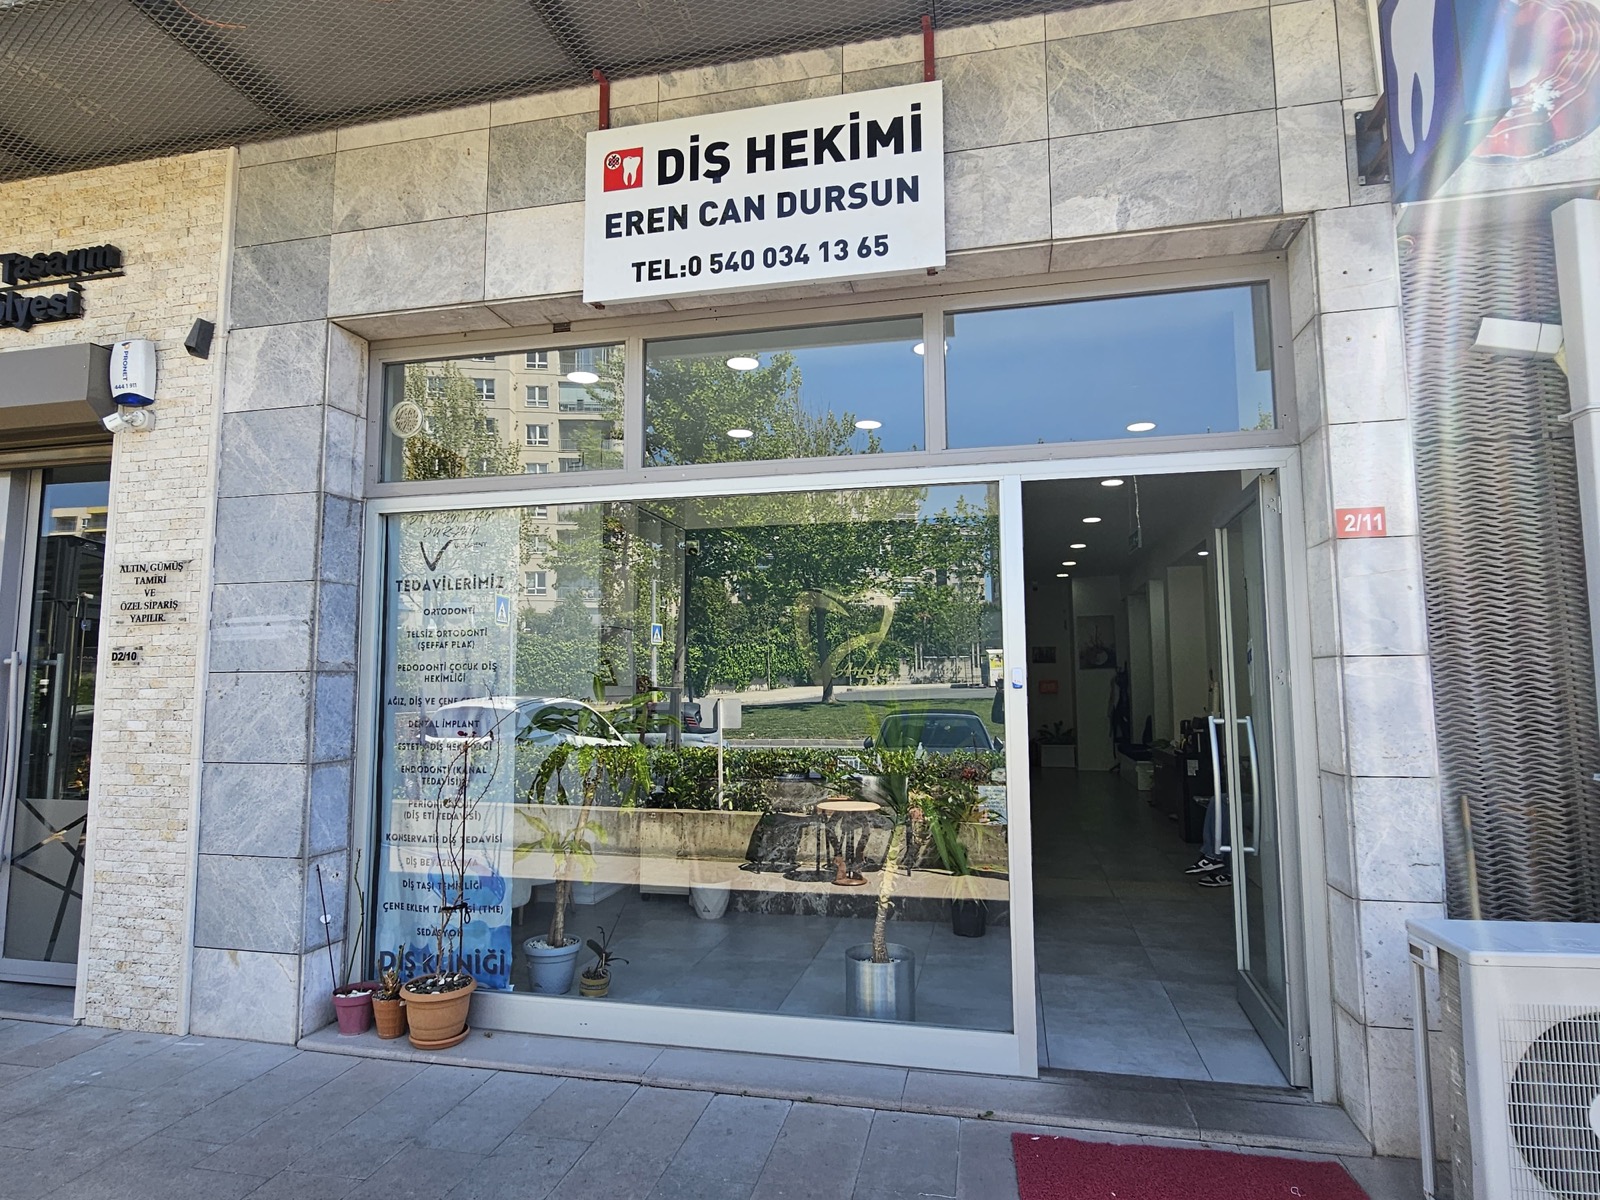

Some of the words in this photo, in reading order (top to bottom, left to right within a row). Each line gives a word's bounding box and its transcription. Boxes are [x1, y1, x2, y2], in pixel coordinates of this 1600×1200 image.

[657, 134, 731, 186] DİŞ
[746, 102, 923, 176] HEKİMİ
[605, 203, 689, 240] EREN
[698, 194, 765, 228] CAN
[776, 175, 920, 220] DURSUN
[709, 249, 754, 274] 540
[762, 244, 810, 269] 034
[818, 238, 849, 263] 13
[856, 234, 889, 259] 65
[1344, 513, 1383, 532] 2/11
[119, 563, 148, 574] ALTIN,
[150, 560, 184, 573] GÜMÜŞ
[134, 573, 167, 585] TAMİRİ
[396, 573, 504, 593] TEDAVİLERİMİZ
[144, 589, 156, 597] VE
[120, 601, 142, 611] ÖZEL
[143, 598, 178, 611] SİPARİŞ
[130, 613, 166, 623] YAPILIR.
[407, 629, 433, 638] TELSİZ
[436, 627, 488, 638] ORTODONTİ
[111, 651, 137, 661] D2/10
[397, 662, 447, 672] PEDODONTİ
[449, 662, 478, 673] ÇOCUK
[481, 660, 498, 671] DİŞ
[424, 671, 466, 683] HEKİMLİĞİ
[409, 696, 422, 707] DİŞ
[442, 718, 480, 728] İMPLANT
[422, 810, 434, 820] ETİ
[405, 856, 417, 868] DİŞ
[402, 878, 414, 892] DİŞ
[382, 902, 405, 912] ÇENE
[406, 903, 430, 913] EKLEM
[478, 905, 504, 915] (TME)
